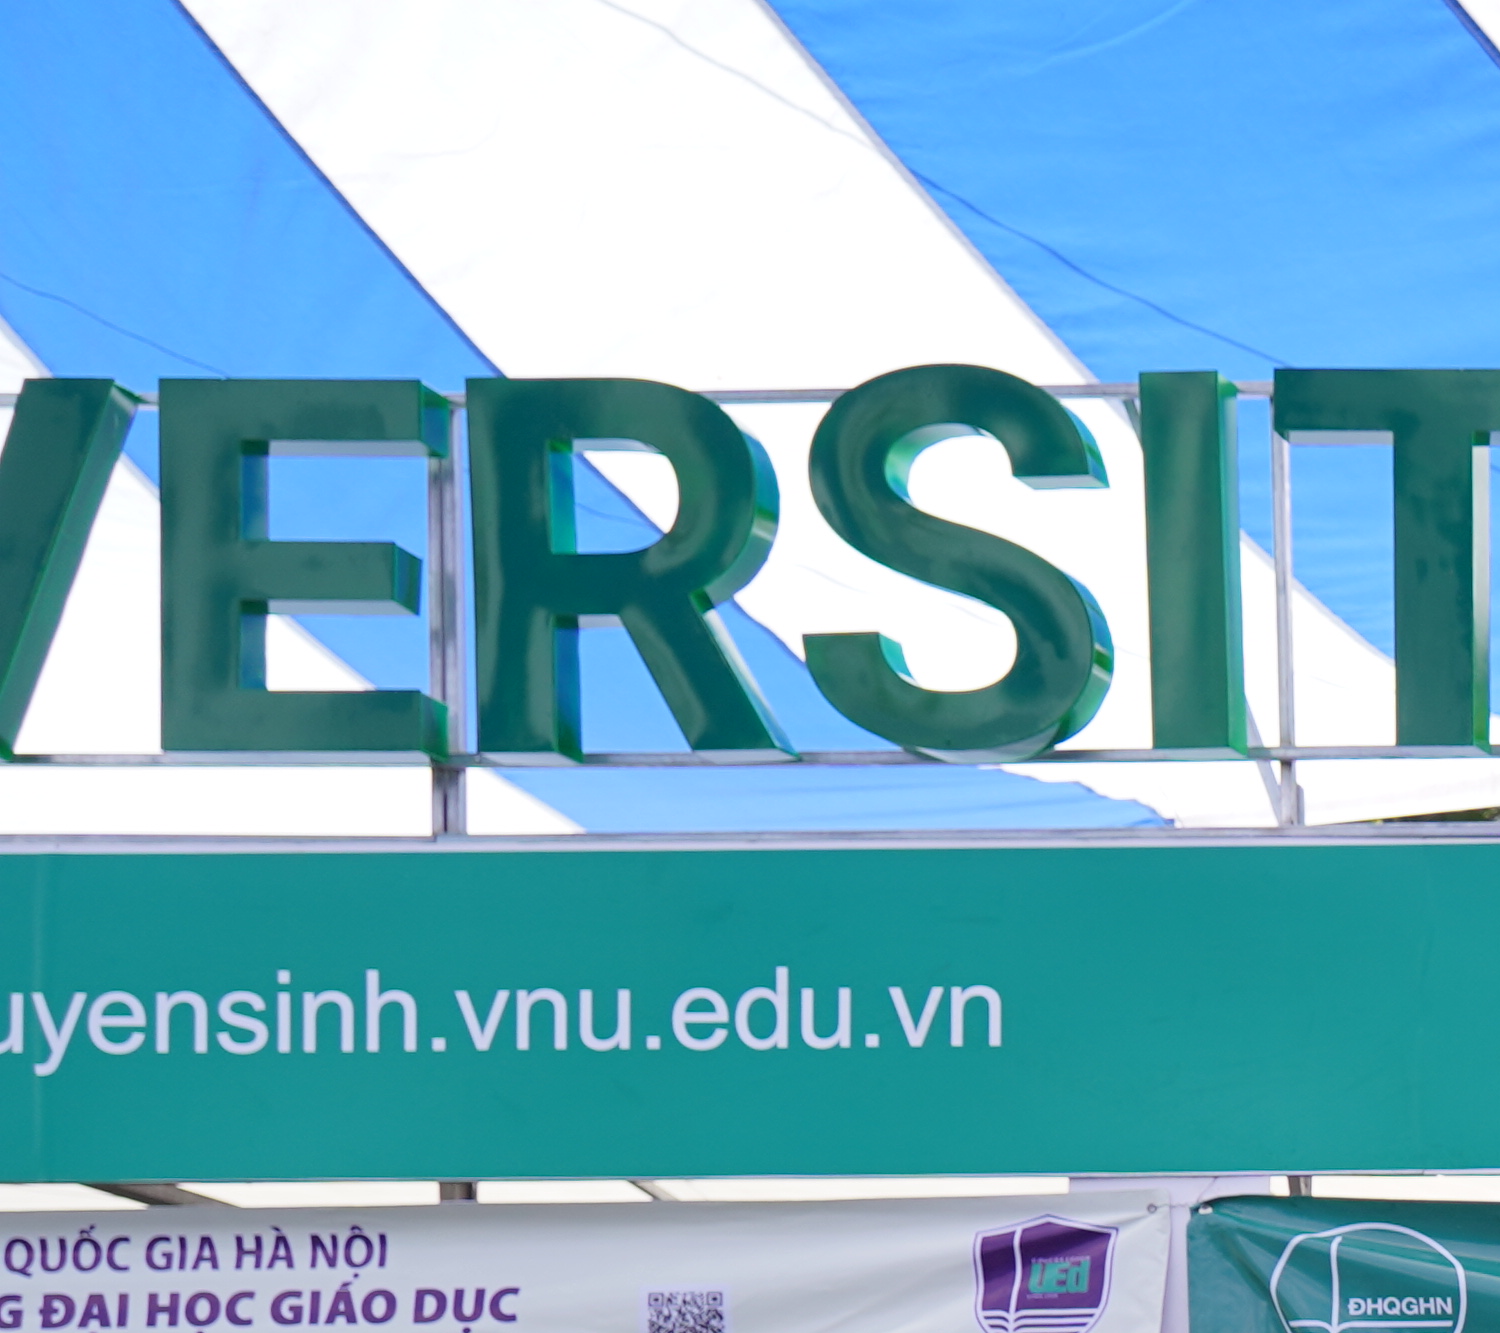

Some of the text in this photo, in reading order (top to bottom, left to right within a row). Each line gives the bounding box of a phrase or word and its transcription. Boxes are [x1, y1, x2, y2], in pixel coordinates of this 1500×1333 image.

[4, 1224, 388, 1279] QUỐC GIA HÀ NỘI
[269, 1281, 399, 1326] GIÁO
[1348, 1296, 1454, 1318] ĐHQGHN
